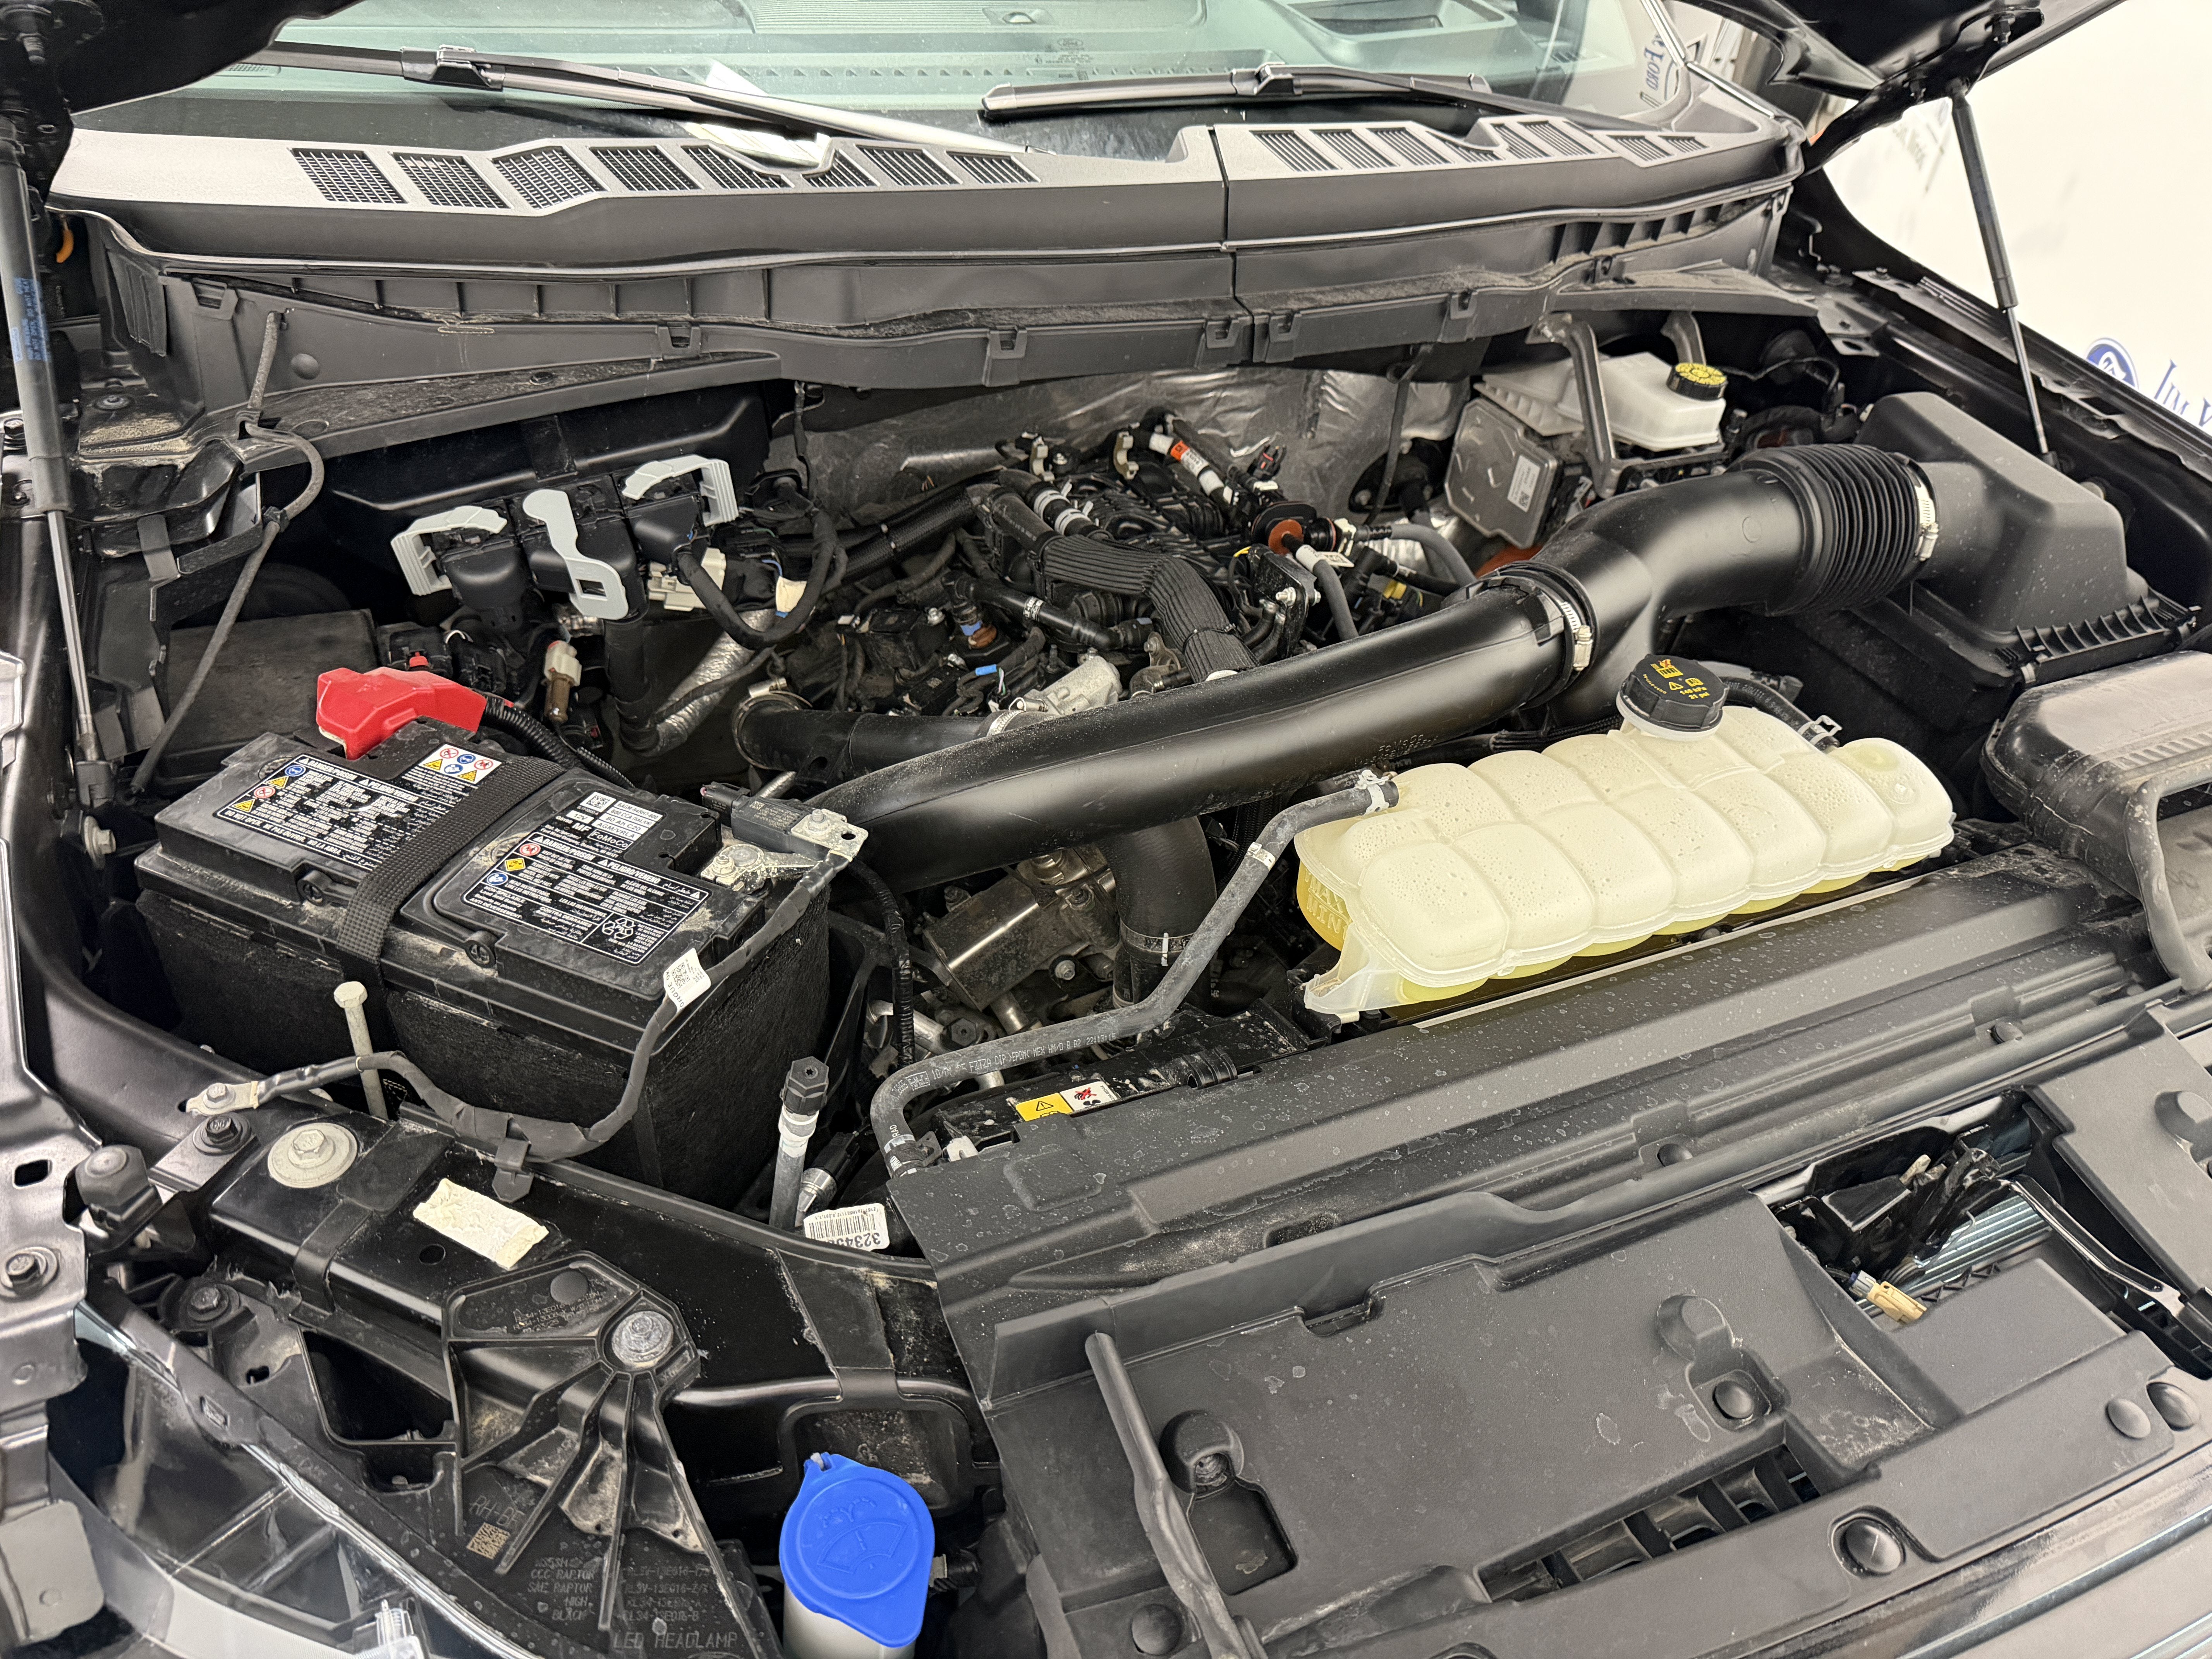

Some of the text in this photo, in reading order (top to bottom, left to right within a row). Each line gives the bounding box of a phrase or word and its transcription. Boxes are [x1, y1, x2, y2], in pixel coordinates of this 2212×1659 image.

[306, 760, 359, 781] DANGER/POISON
[367, 781, 420, 802] PELIGRO/VENENO
[571, 822, 592, 833] MF
[596, 822, 637, 838] AGM/VRLA
[590, 831, 629, 848] FoMoCo
[541, 839, 596, 861] DANGER/POISON
[606, 861, 662, 884] PELIGRO/VENENO
[483, 886, 526, 903] NON-SPILLABLE
[1310, 875, 1343, 913] MAX
[499, 903, 518, 912] plomb
[502, 898, 523, 908] Battery
[539, 906, 592, 927] CONTRA DERRAMES
[1307, 894, 1341, 934] MIN
[668, 981, 684, 1008] ORQUE
[892, 1124, 902, 1138] RAD
[613, 1631, 738, 1649] LED HEADLAMP
